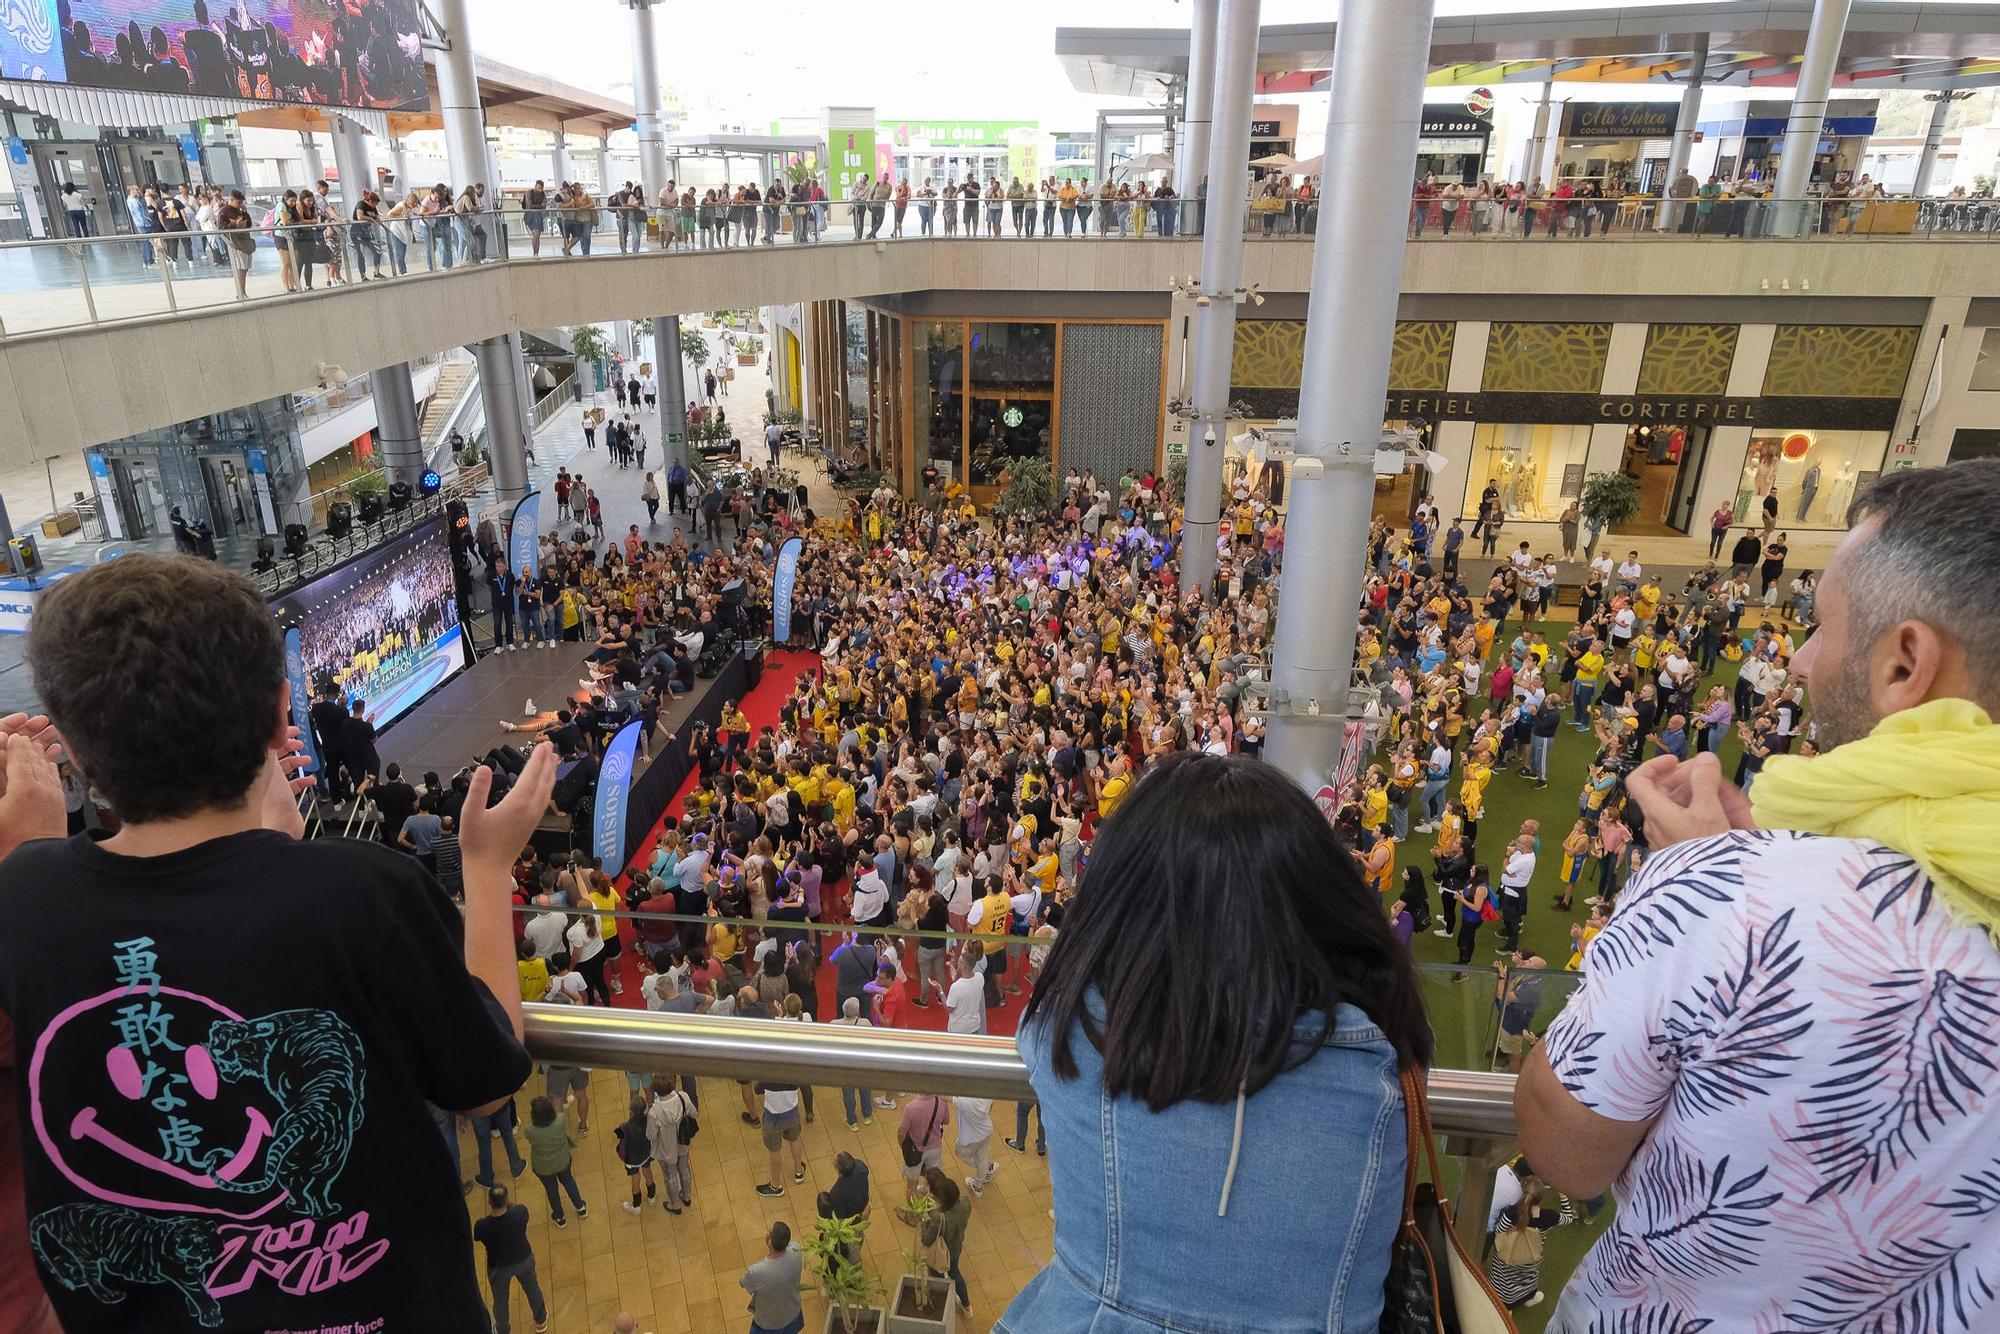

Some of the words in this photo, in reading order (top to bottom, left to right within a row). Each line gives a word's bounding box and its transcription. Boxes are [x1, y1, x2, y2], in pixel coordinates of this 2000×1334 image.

[1251, 123, 1270, 133] AFÉ
[1424, 123, 1444, 131] HOT
[1449, 123, 1478, 131] DOGS
[1580, 127, 1608, 135] COCINA
[1609, 127, 1634, 135] TURCA
[1641, 127, 1667, 135] KEBAB
[1385, 399, 1474, 414] TEFIEL
[1600, 402, 1755, 419] CORTEFIEL
[600, 784, 622, 858] alisios
[991, 917, 1005, 932] 13
[355, 1316, 385, 1334] force
